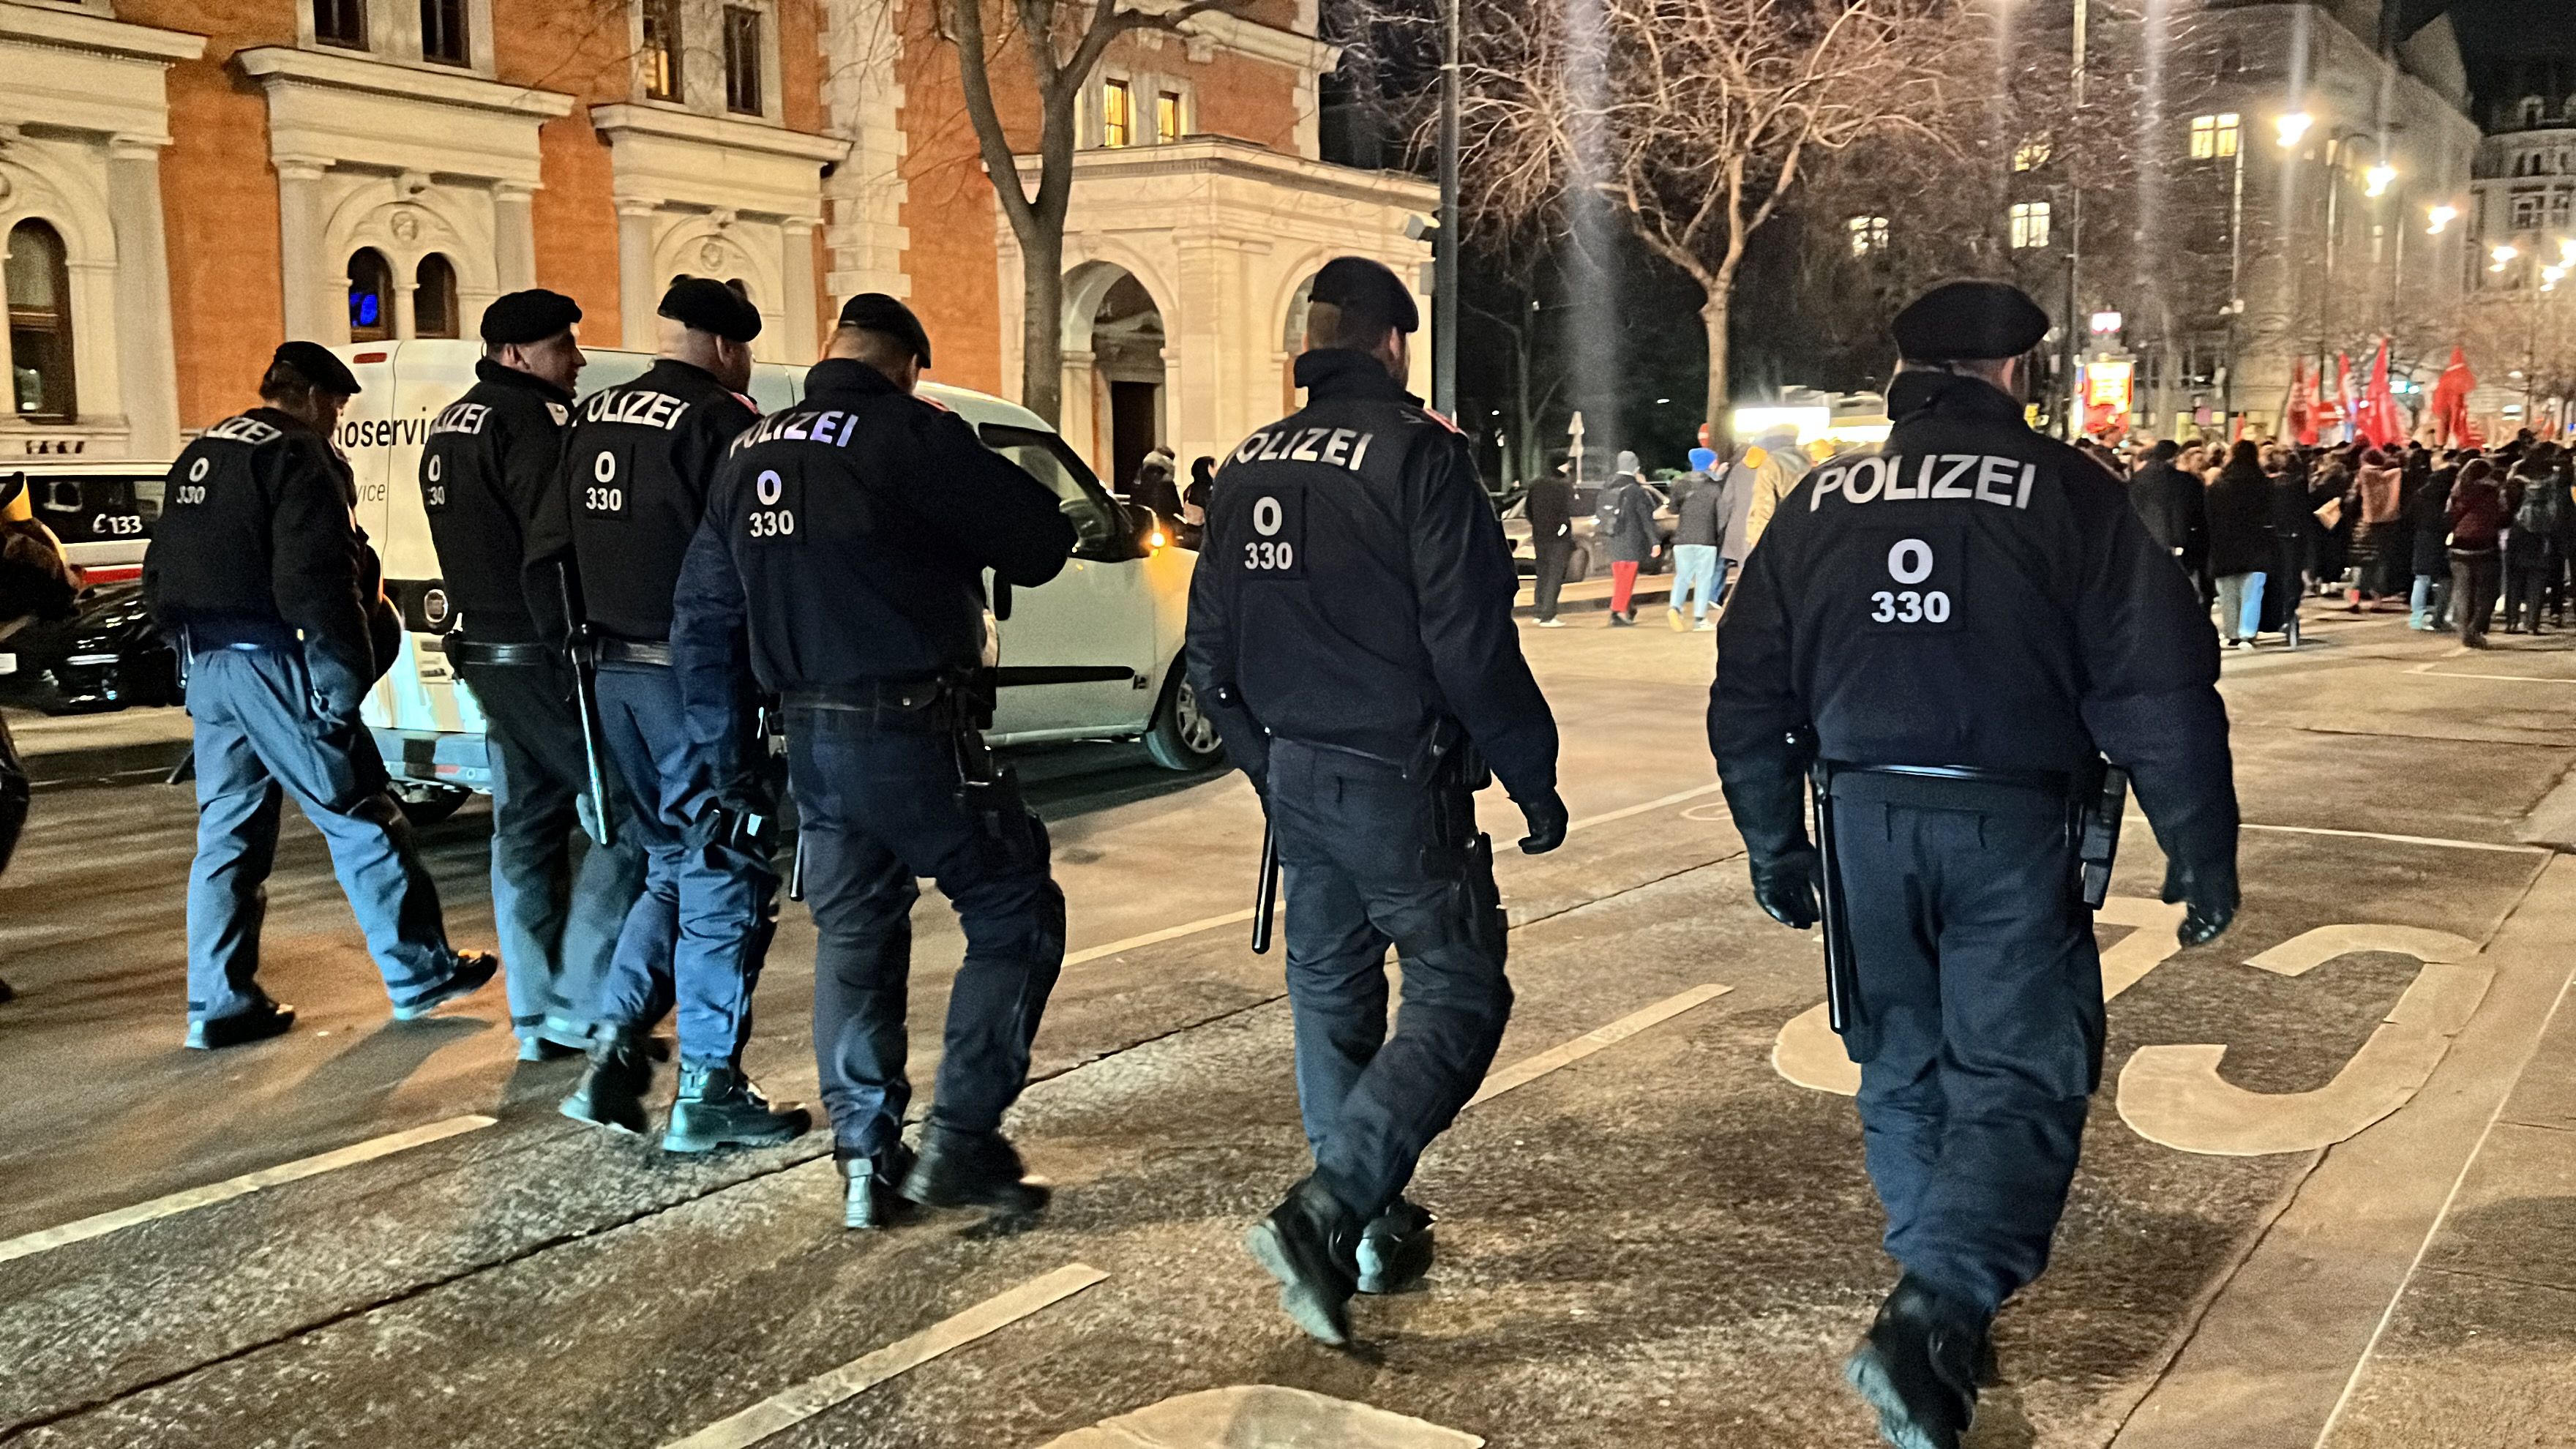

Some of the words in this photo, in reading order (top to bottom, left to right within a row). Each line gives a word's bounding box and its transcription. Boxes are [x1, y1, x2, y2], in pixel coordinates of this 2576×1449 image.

[430, 402, 493, 435] LIZEI
[572, 389, 691, 431] OLIZEI
[205, 416, 282, 445] LIZEI
[427, 485, 445, 505] 30
[1810, 454, 2037, 512] POLIZEI
[585, 487, 622, 512] 330
[749, 509, 795, 537] 330
[1244, 542, 1293, 570] 330
[1871, 591, 1950, 624] 330
